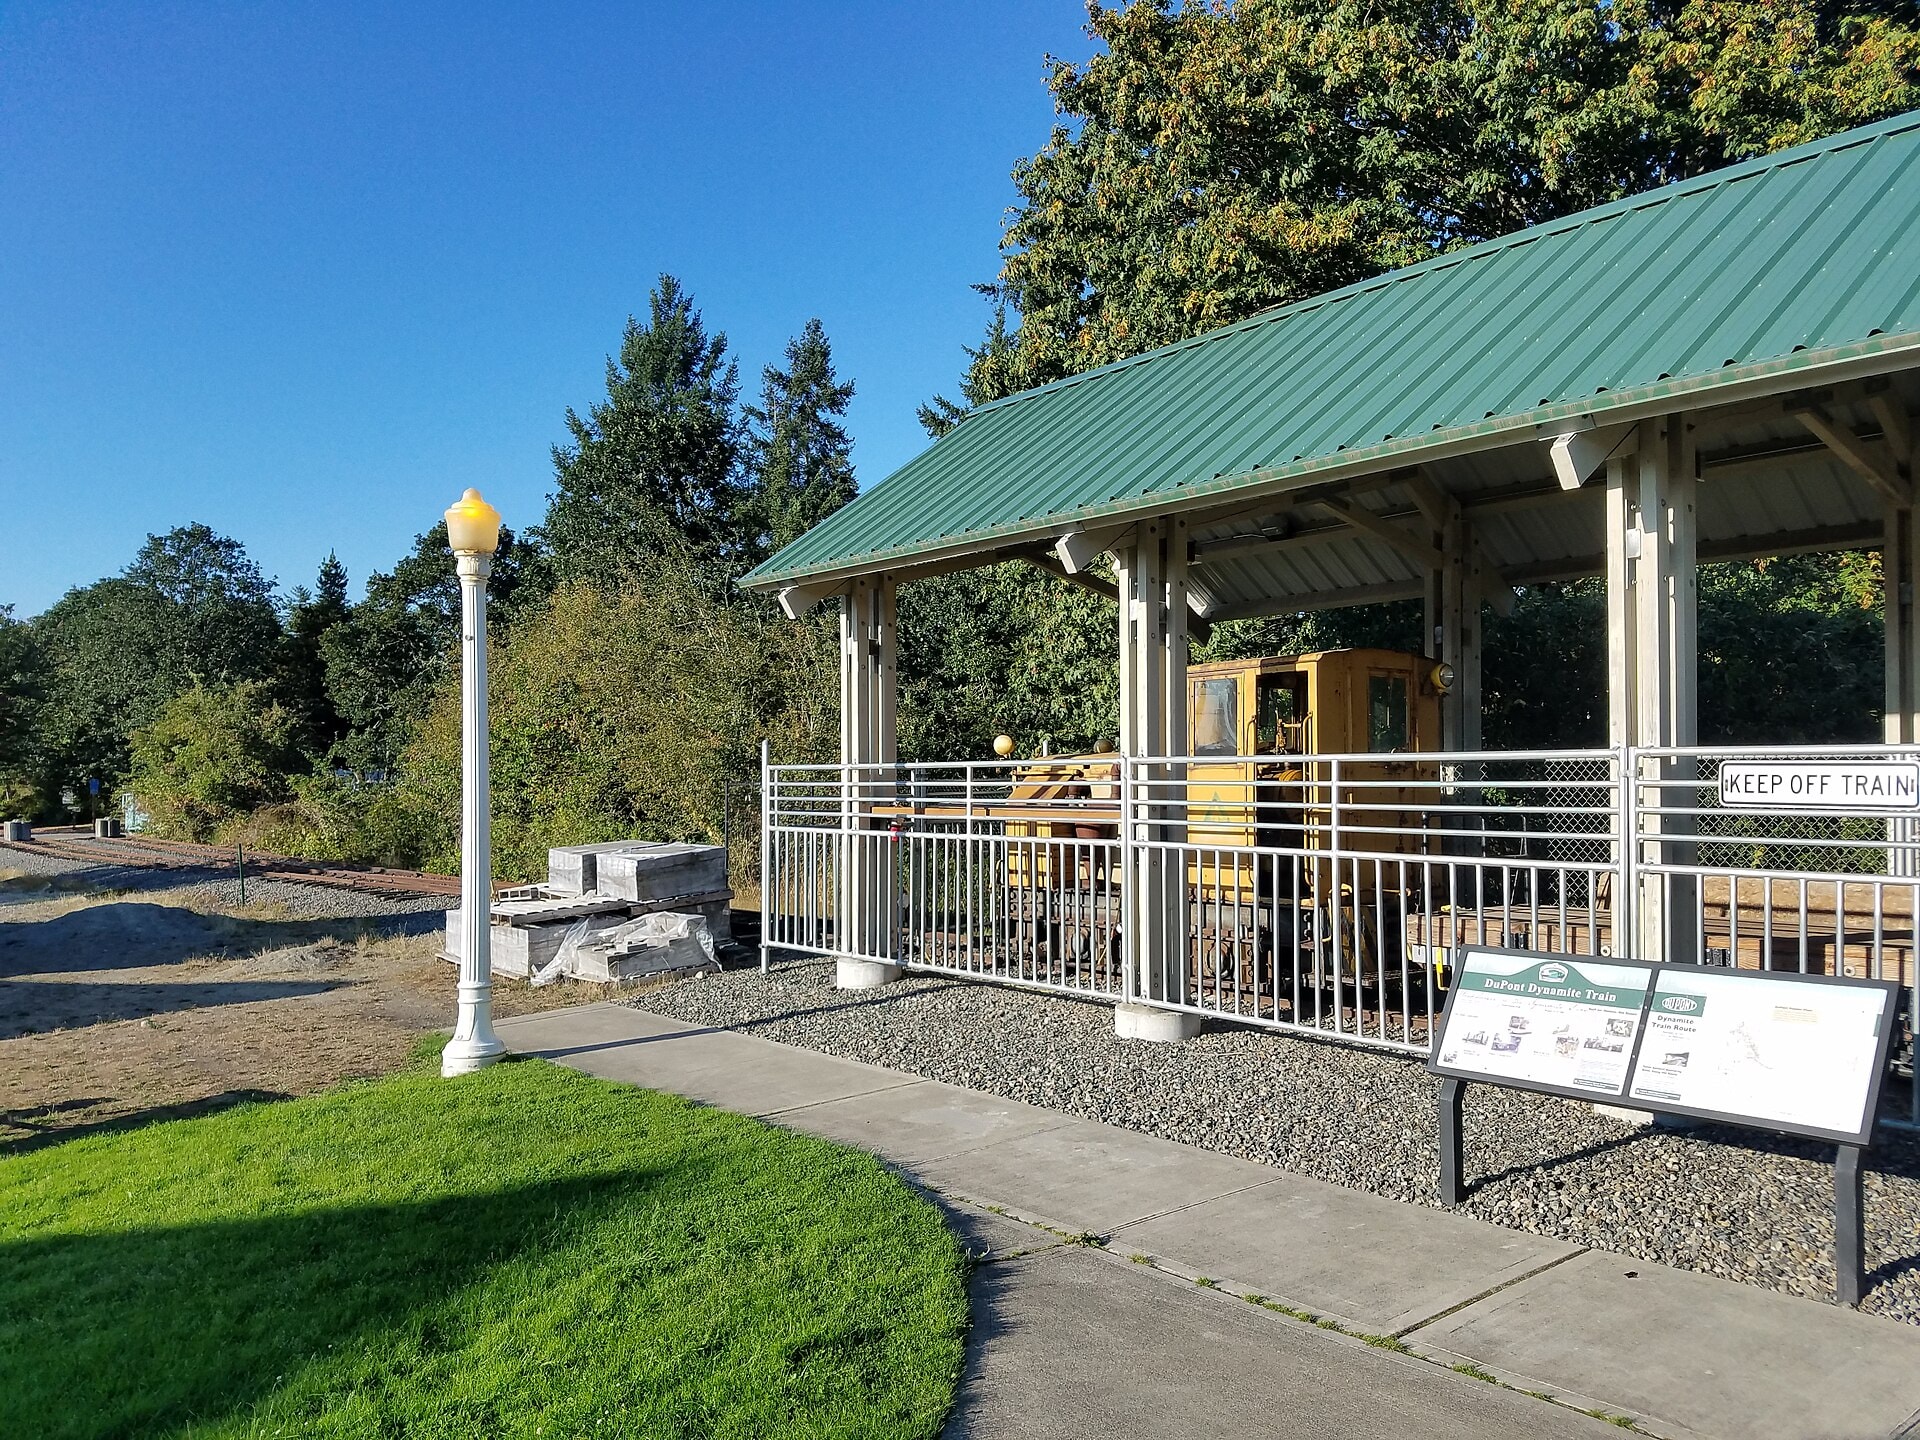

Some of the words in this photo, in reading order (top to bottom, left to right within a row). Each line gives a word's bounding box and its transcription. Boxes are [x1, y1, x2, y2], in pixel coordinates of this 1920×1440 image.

[1730, 774, 1783, 793] KEEP
[1790, 775, 1831, 795] OFF
[1842, 775, 1909, 796] TRAIN
[1484, 978, 1525, 991] DuPont
[1528, 983, 1582, 998] Dynamite
[1585, 989, 1617, 1002] Train
[1651, 1022, 1672, 1030] Train
[1673, 1025, 1697, 1033] Route
[1657, 1015, 1694, 1025] Dynamite
